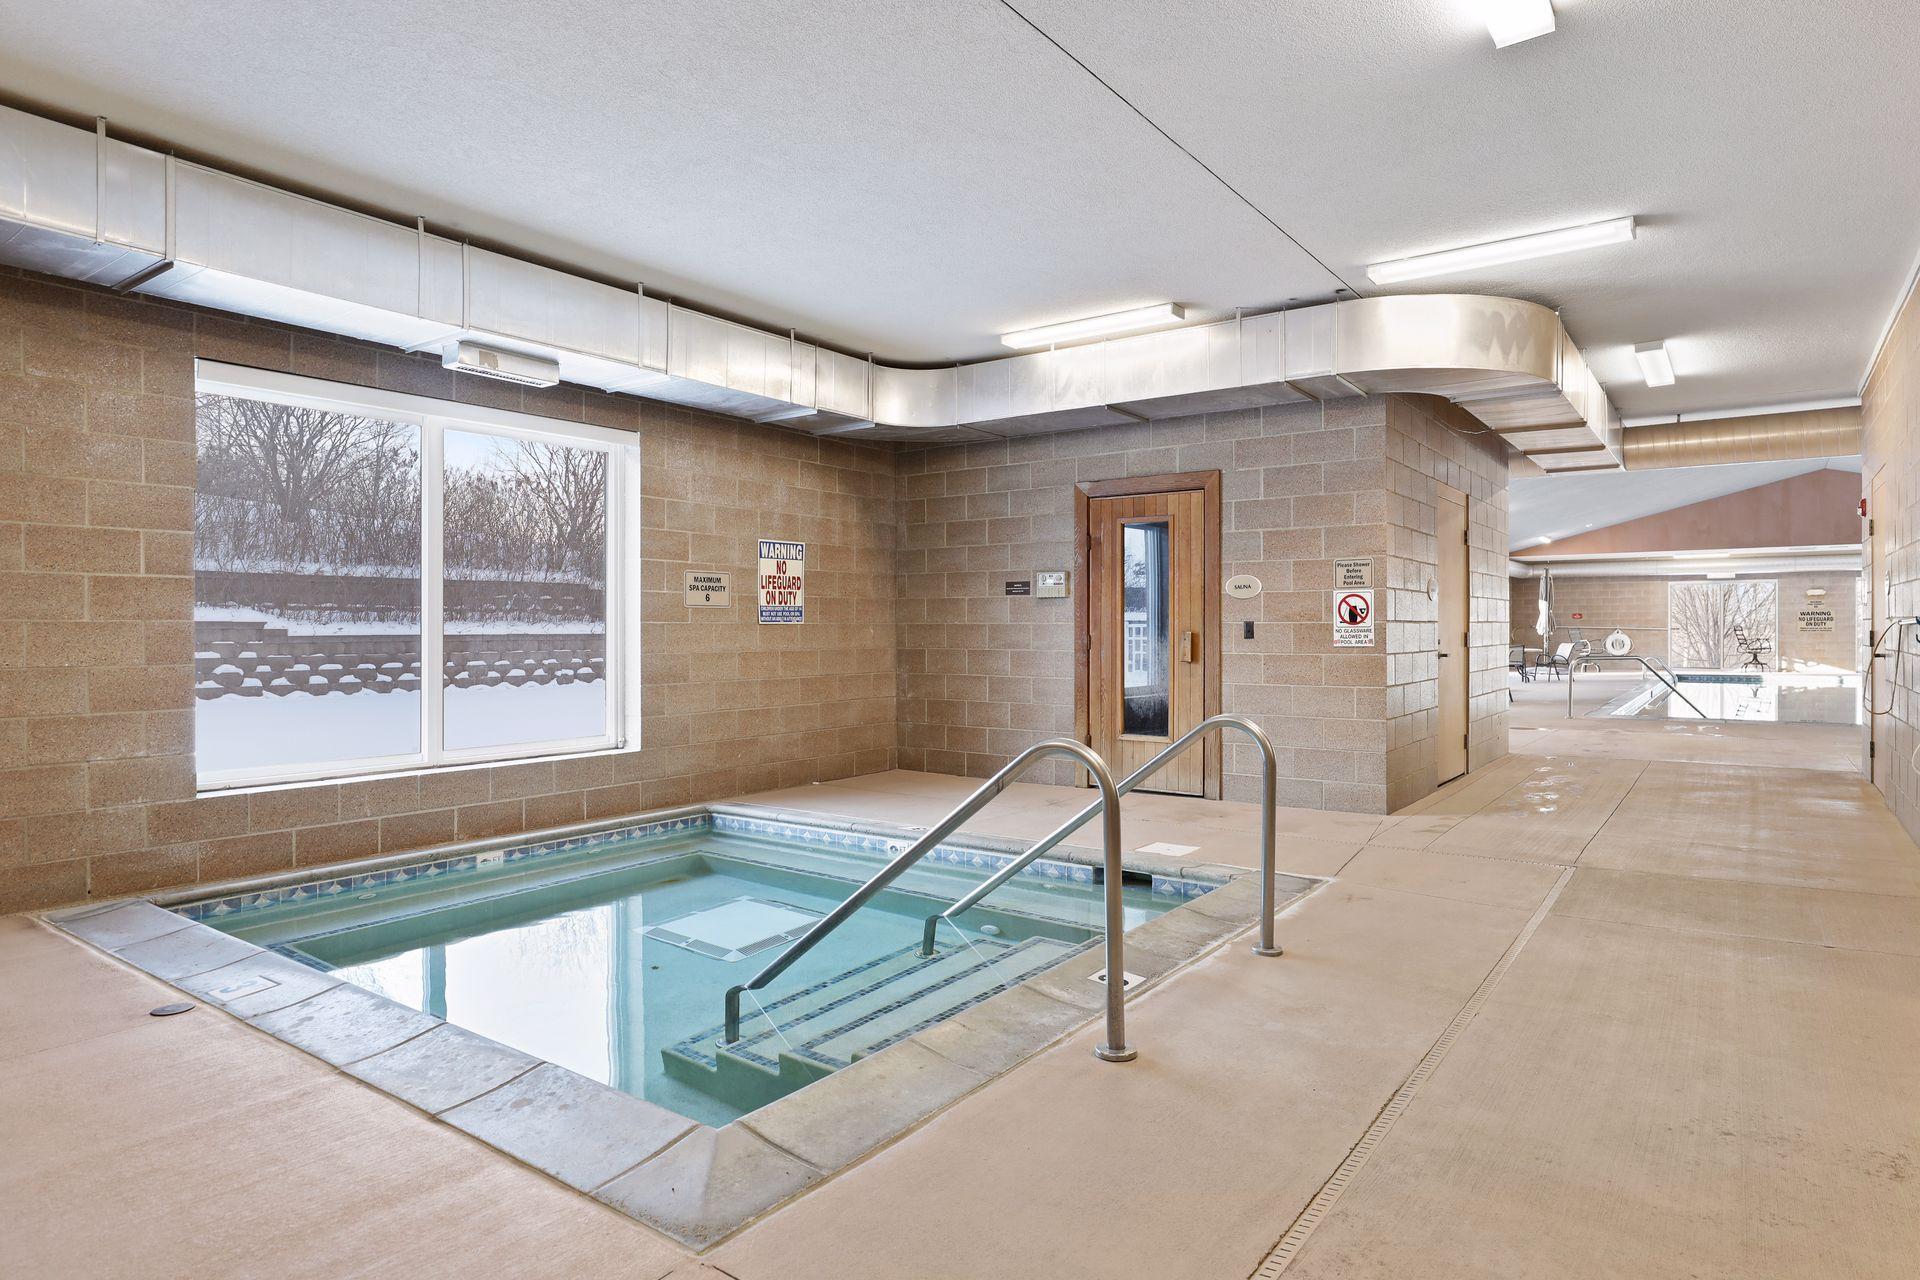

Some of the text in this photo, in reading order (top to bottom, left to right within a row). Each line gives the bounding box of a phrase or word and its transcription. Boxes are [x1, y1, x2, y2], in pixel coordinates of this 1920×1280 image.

[760, 542, 803, 560] WARNING
[776, 560, 787, 575] NO
[760, 575, 802, 590] LIFEGUARD
[705, 593, 711, 602] 6
[766, 590, 798, 606] ON DUTY
